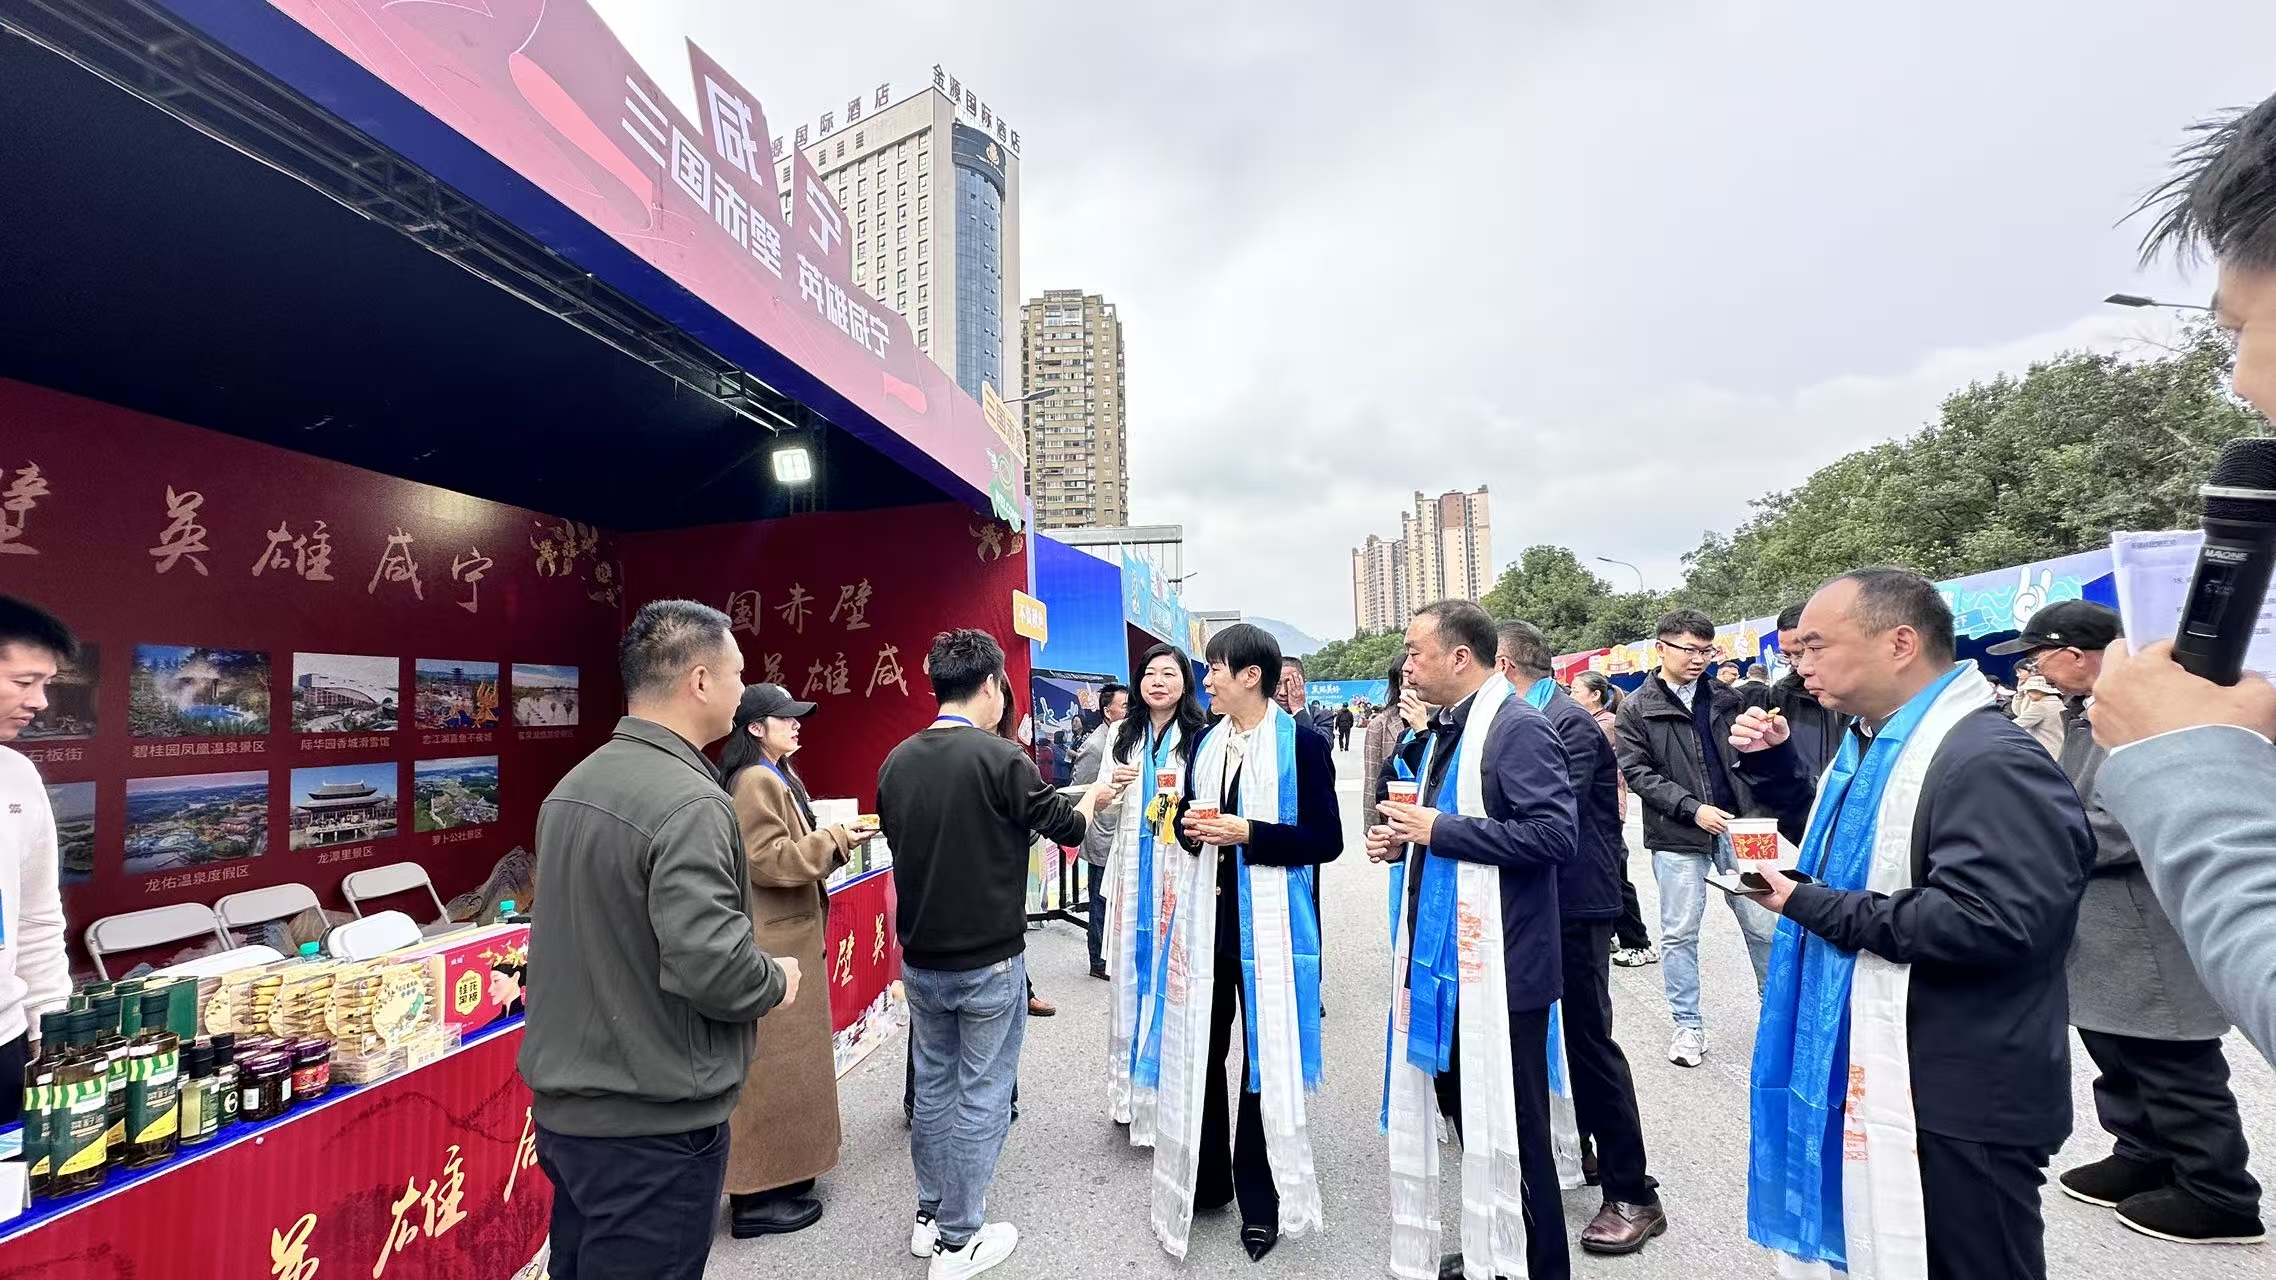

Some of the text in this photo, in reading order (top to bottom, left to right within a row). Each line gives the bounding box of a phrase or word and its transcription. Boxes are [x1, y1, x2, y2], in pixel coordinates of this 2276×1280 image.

[932, 63, 1021, 153] 金源国际酒店
[621, 74, 890, 359] 三国赤壁 英雄咸宁
[994, 489, 1020, 525] WELCOME
[149, 485, 494, 613] 英雄咸宁
[763, 643, 930, 700] 英雄咸
[132, 740, 266, 759] 碧桂园凤凰温泉景区
[301, 736, 391, 751] 际华园香城滑雪馆
[145, 864, 250, 893] 龙佑温泉度假区
